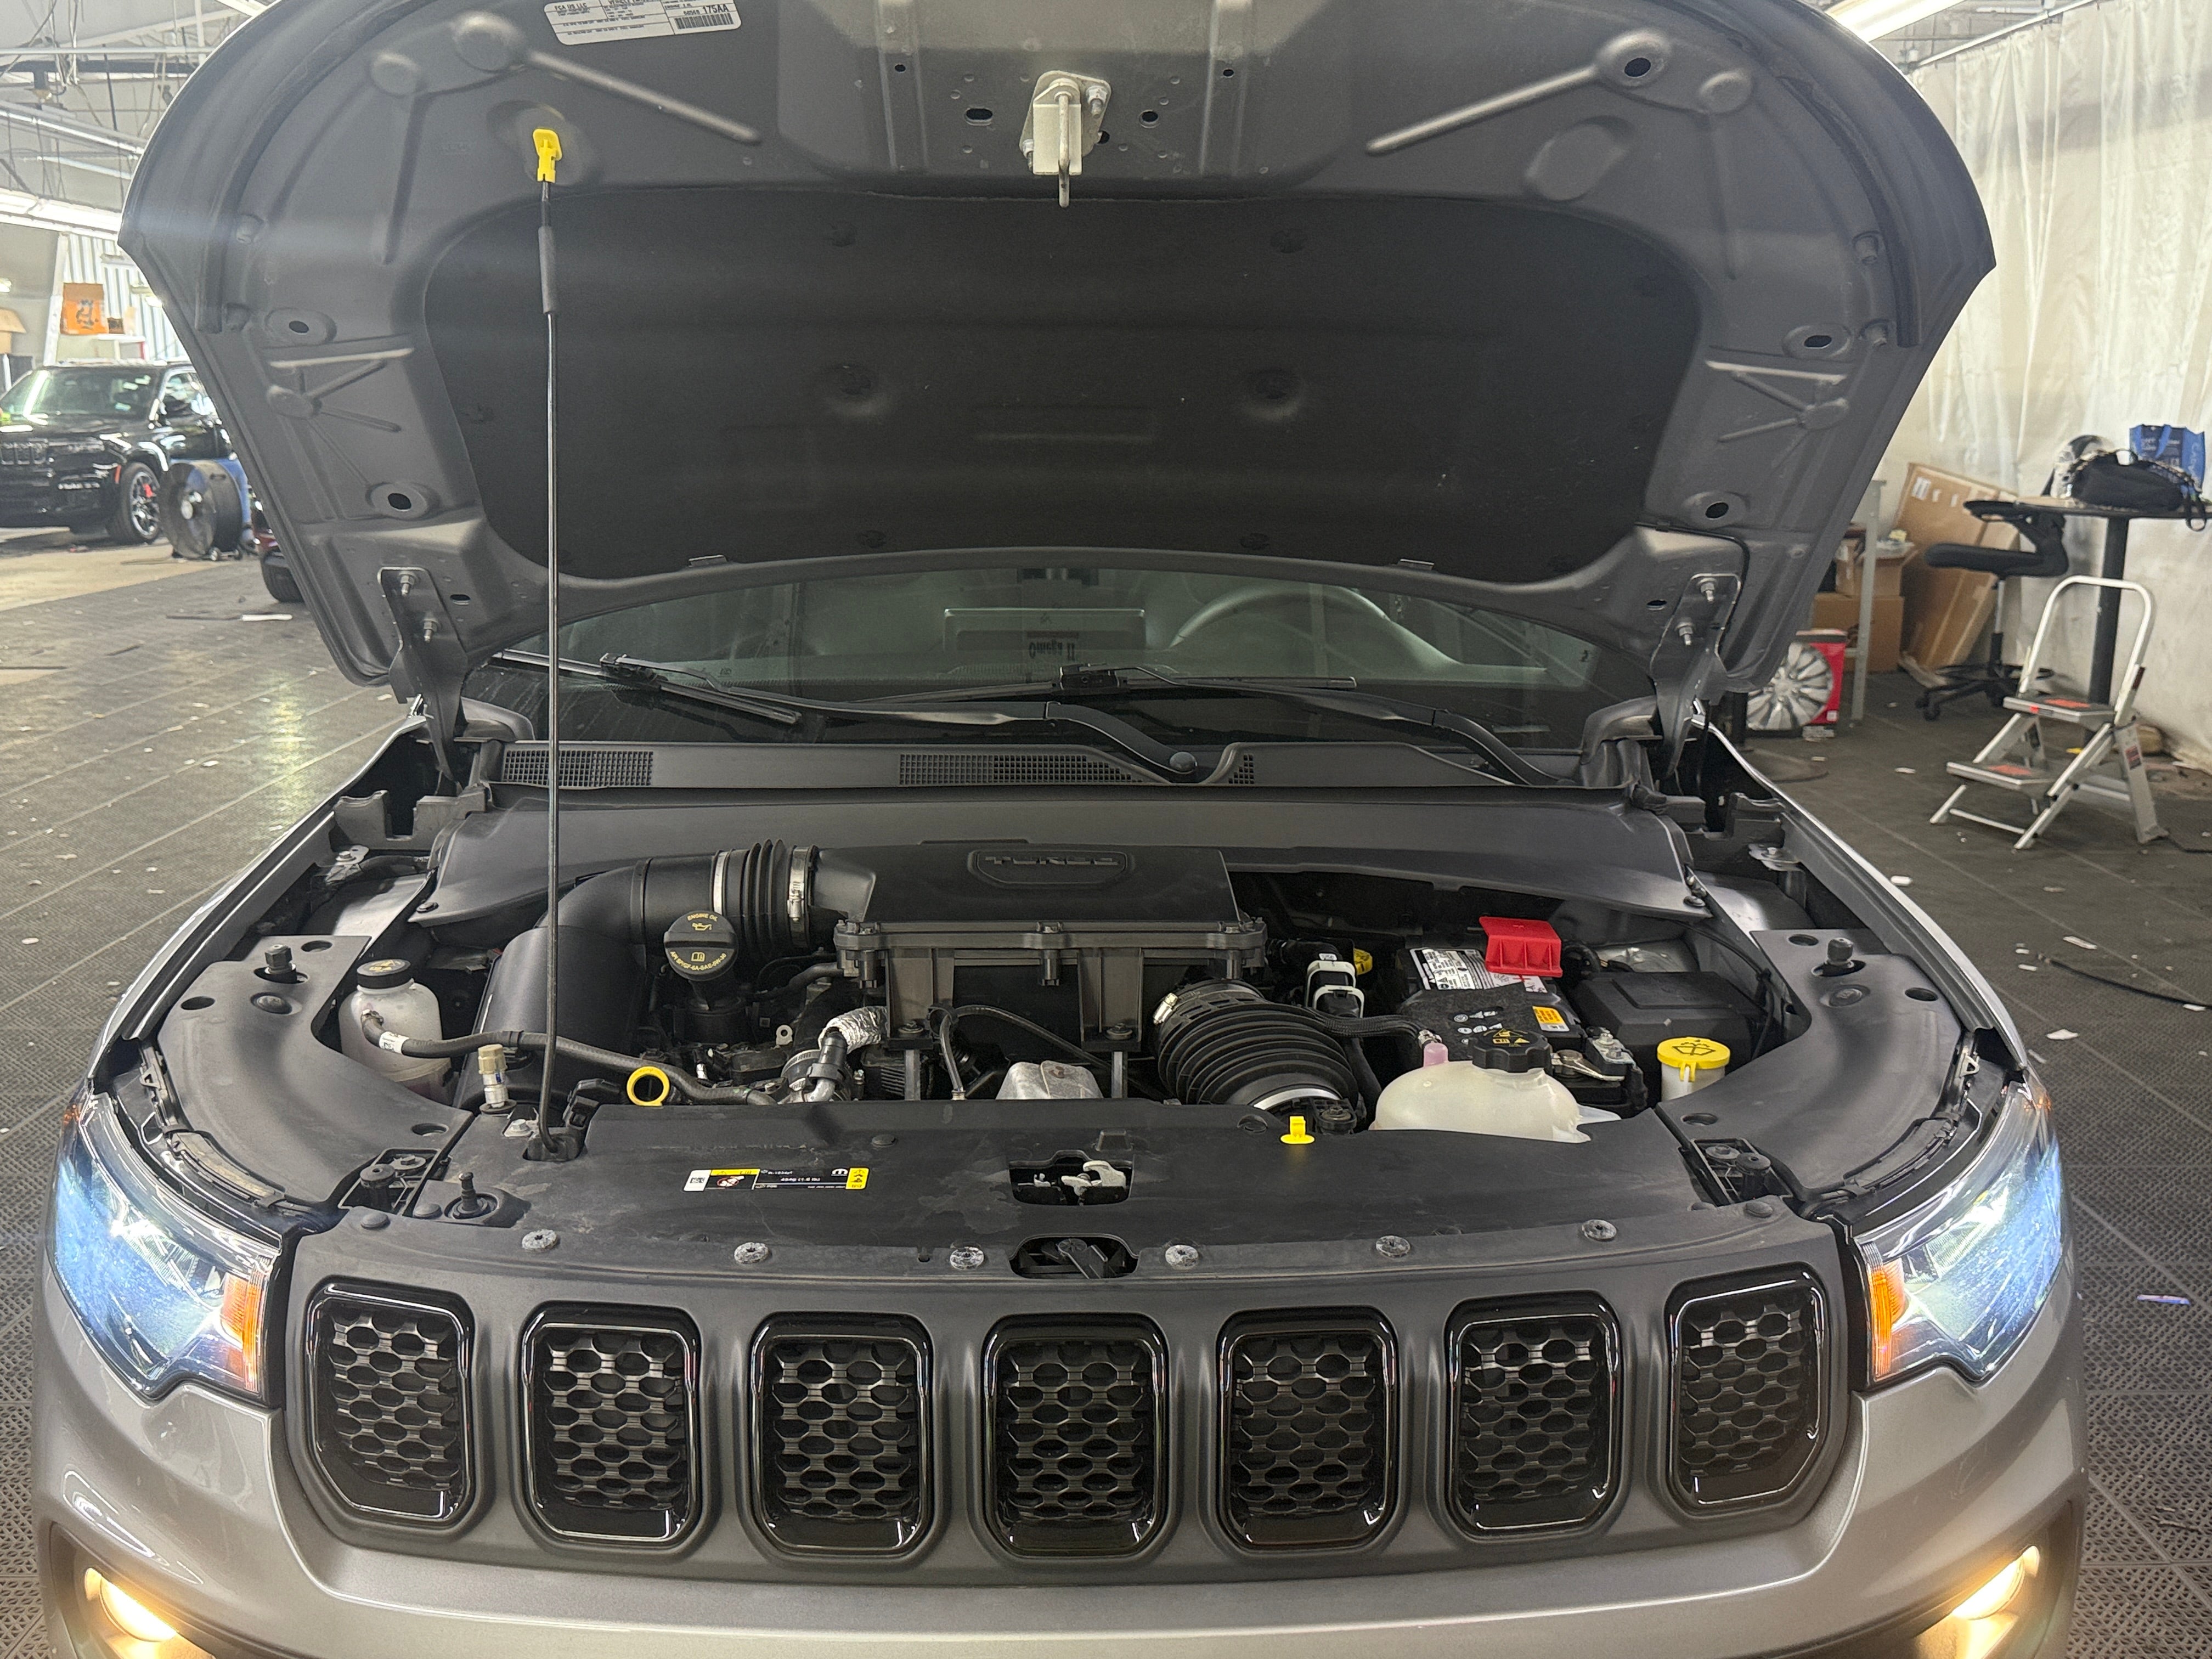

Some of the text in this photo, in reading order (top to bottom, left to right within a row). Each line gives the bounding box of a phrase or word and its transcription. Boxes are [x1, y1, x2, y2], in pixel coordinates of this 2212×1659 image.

[702, 4, 729, 14] 175AA
[687, 913, 709, 921] ENGINE
[670, 951, 679, 960] API
